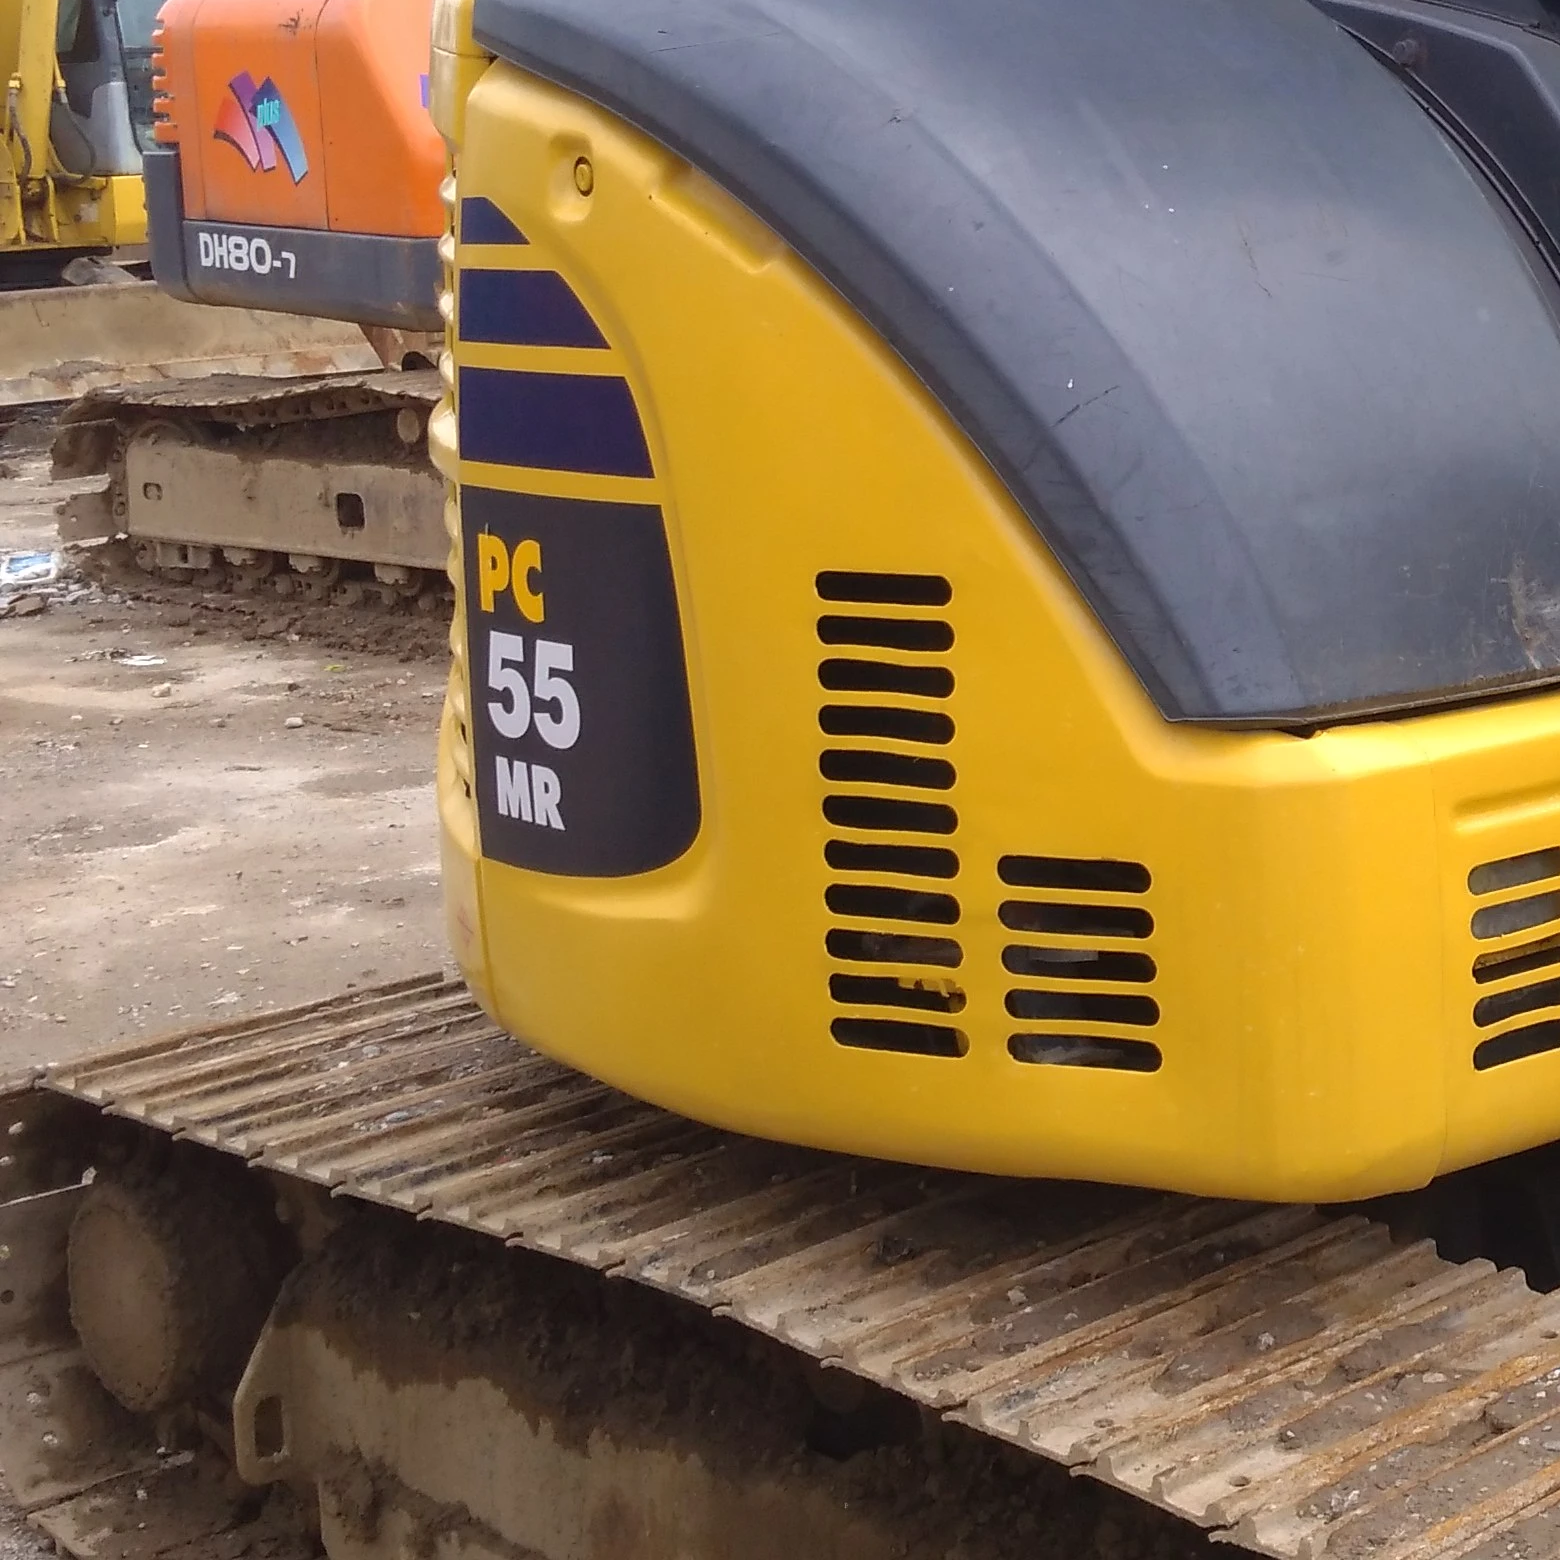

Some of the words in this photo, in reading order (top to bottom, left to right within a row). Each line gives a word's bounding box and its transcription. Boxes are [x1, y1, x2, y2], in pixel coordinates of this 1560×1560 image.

[256, 97, 281, 132] plus
[198, 232, 296, 279] DH80-7
[477, 532, 546, 624] PC
[487, 629, 581, 750] 55
[495, 755, 567, 832] MR
